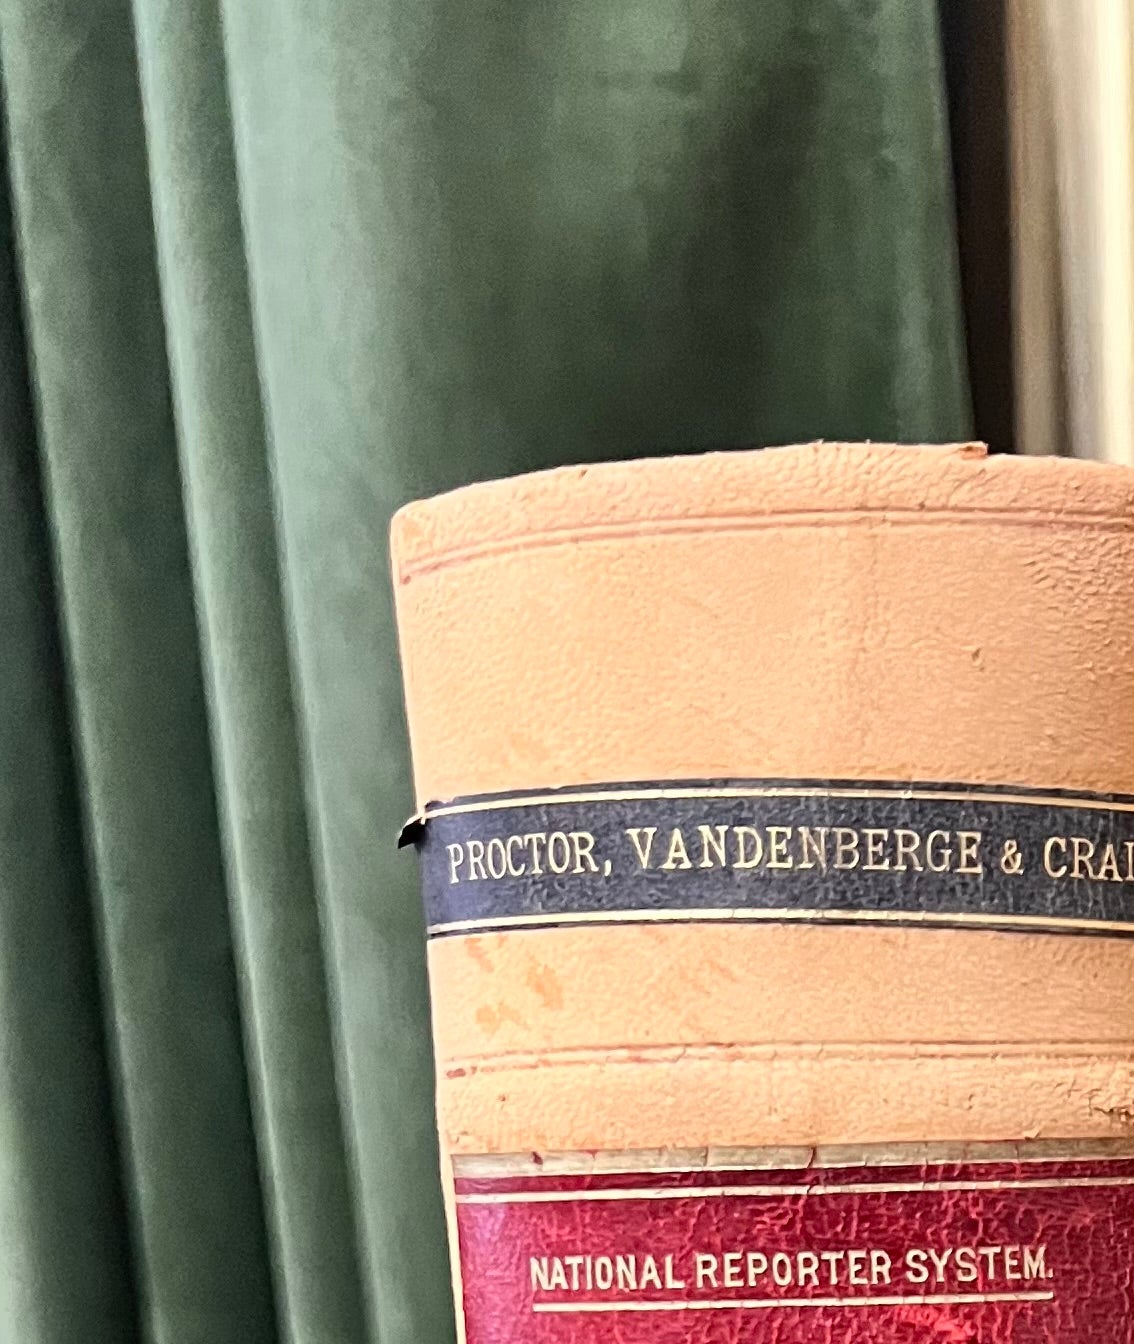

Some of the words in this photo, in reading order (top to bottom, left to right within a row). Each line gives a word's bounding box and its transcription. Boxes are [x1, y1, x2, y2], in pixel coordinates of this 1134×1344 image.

[447, 829, 614, 885] PROCTOR,
[625, 823, 984, 876] VANDENBERGE
[1000, 845, 1026, 876] &
[529, 1253, 695, 1292] NATIONAL
[696, 1249, 892, 1290] REPORTER
[905, 1245, 1055, 1285] SYSTEM.
